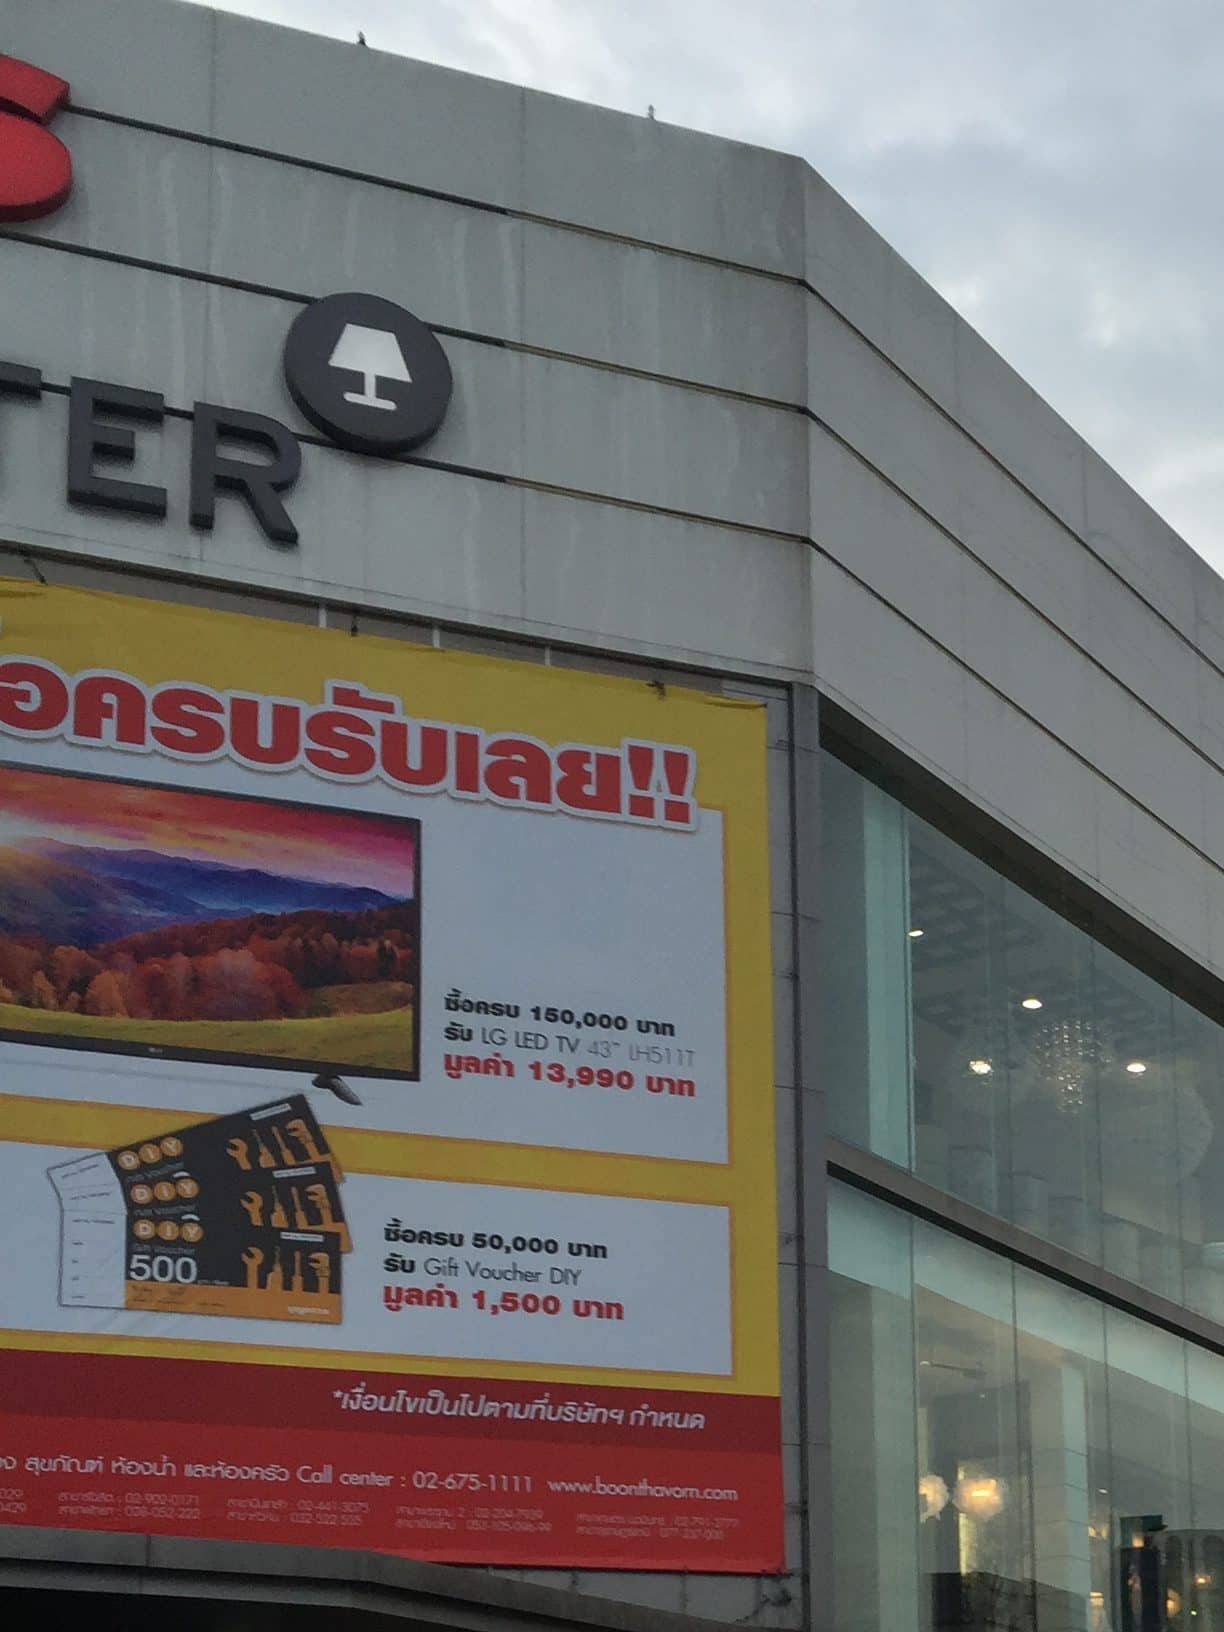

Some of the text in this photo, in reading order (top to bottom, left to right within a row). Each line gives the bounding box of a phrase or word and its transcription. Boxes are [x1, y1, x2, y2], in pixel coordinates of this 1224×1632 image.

[0, 361, 301, 545] ER
[444, 1022, 473, 1042] รับ
[481, 1026, 508, 1046] LG
[515, 1031, 549, 1051] LED
[555, 1035, 580, 1053] TV
[530, 1006, 627, 1030] 150,000
[636, 1019, 675, 1037] บาท
[444, 1053, 696, 1097] มูลค่า 13,990 บาท
[472, 1232, 558, 1256] 50,000
[567, 1241, 608, 1260] บาท
[129, 1254, 198, 1284] 500
[383, 1252, 582, 1286] รับ Gift Voucher DIY
[383, 1284, 624, 1321] มูลค่า 1,500 บาท
[630, 1404, 705, 1430] กำหนด
[296, 1465, 333, 1484] Call
[339, 1471, 393, 1488] center
[412, 1471, 533, 1493] 02-675-1111
[547, 1477, 739, 1502] www.boonthavorn.com
